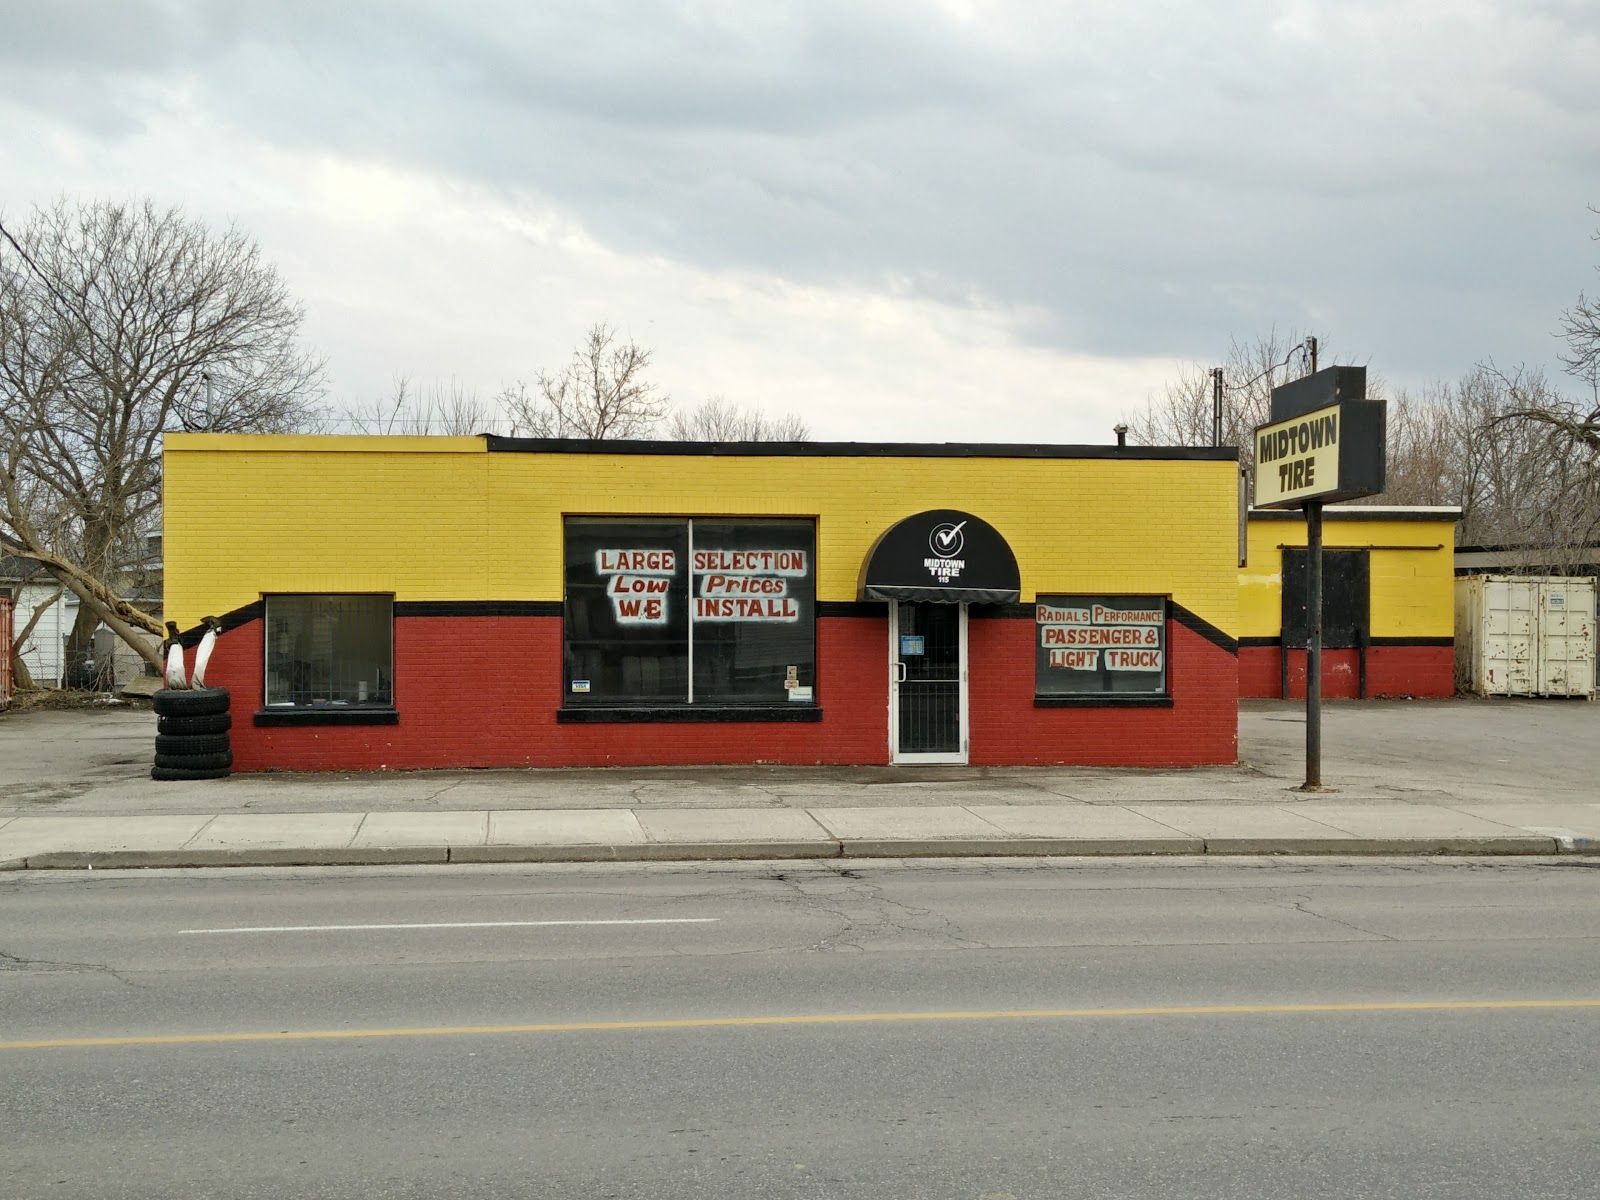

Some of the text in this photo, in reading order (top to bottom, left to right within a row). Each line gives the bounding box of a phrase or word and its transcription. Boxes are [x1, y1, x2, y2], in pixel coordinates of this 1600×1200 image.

[1260, 413, 1337, 464] MIDTOWN
[1279, 457, 1315, 493] TIRE
[600, 552, 803, 570] LARGE SELECTION
[924, 558, 965, 569] MIDTOWN
[929, 567, 960, 577] TIRE
[706, 575, 784, 593] Prices
[619, 599, 796, 619] WE INSTALL
[1037, 606, 1162, 622] RADIALS PERFORMANCE
[1045, 629, 1157, 644] PASSENGER &
[1051, 651, 1160, 667] LIGHT TRUCK
